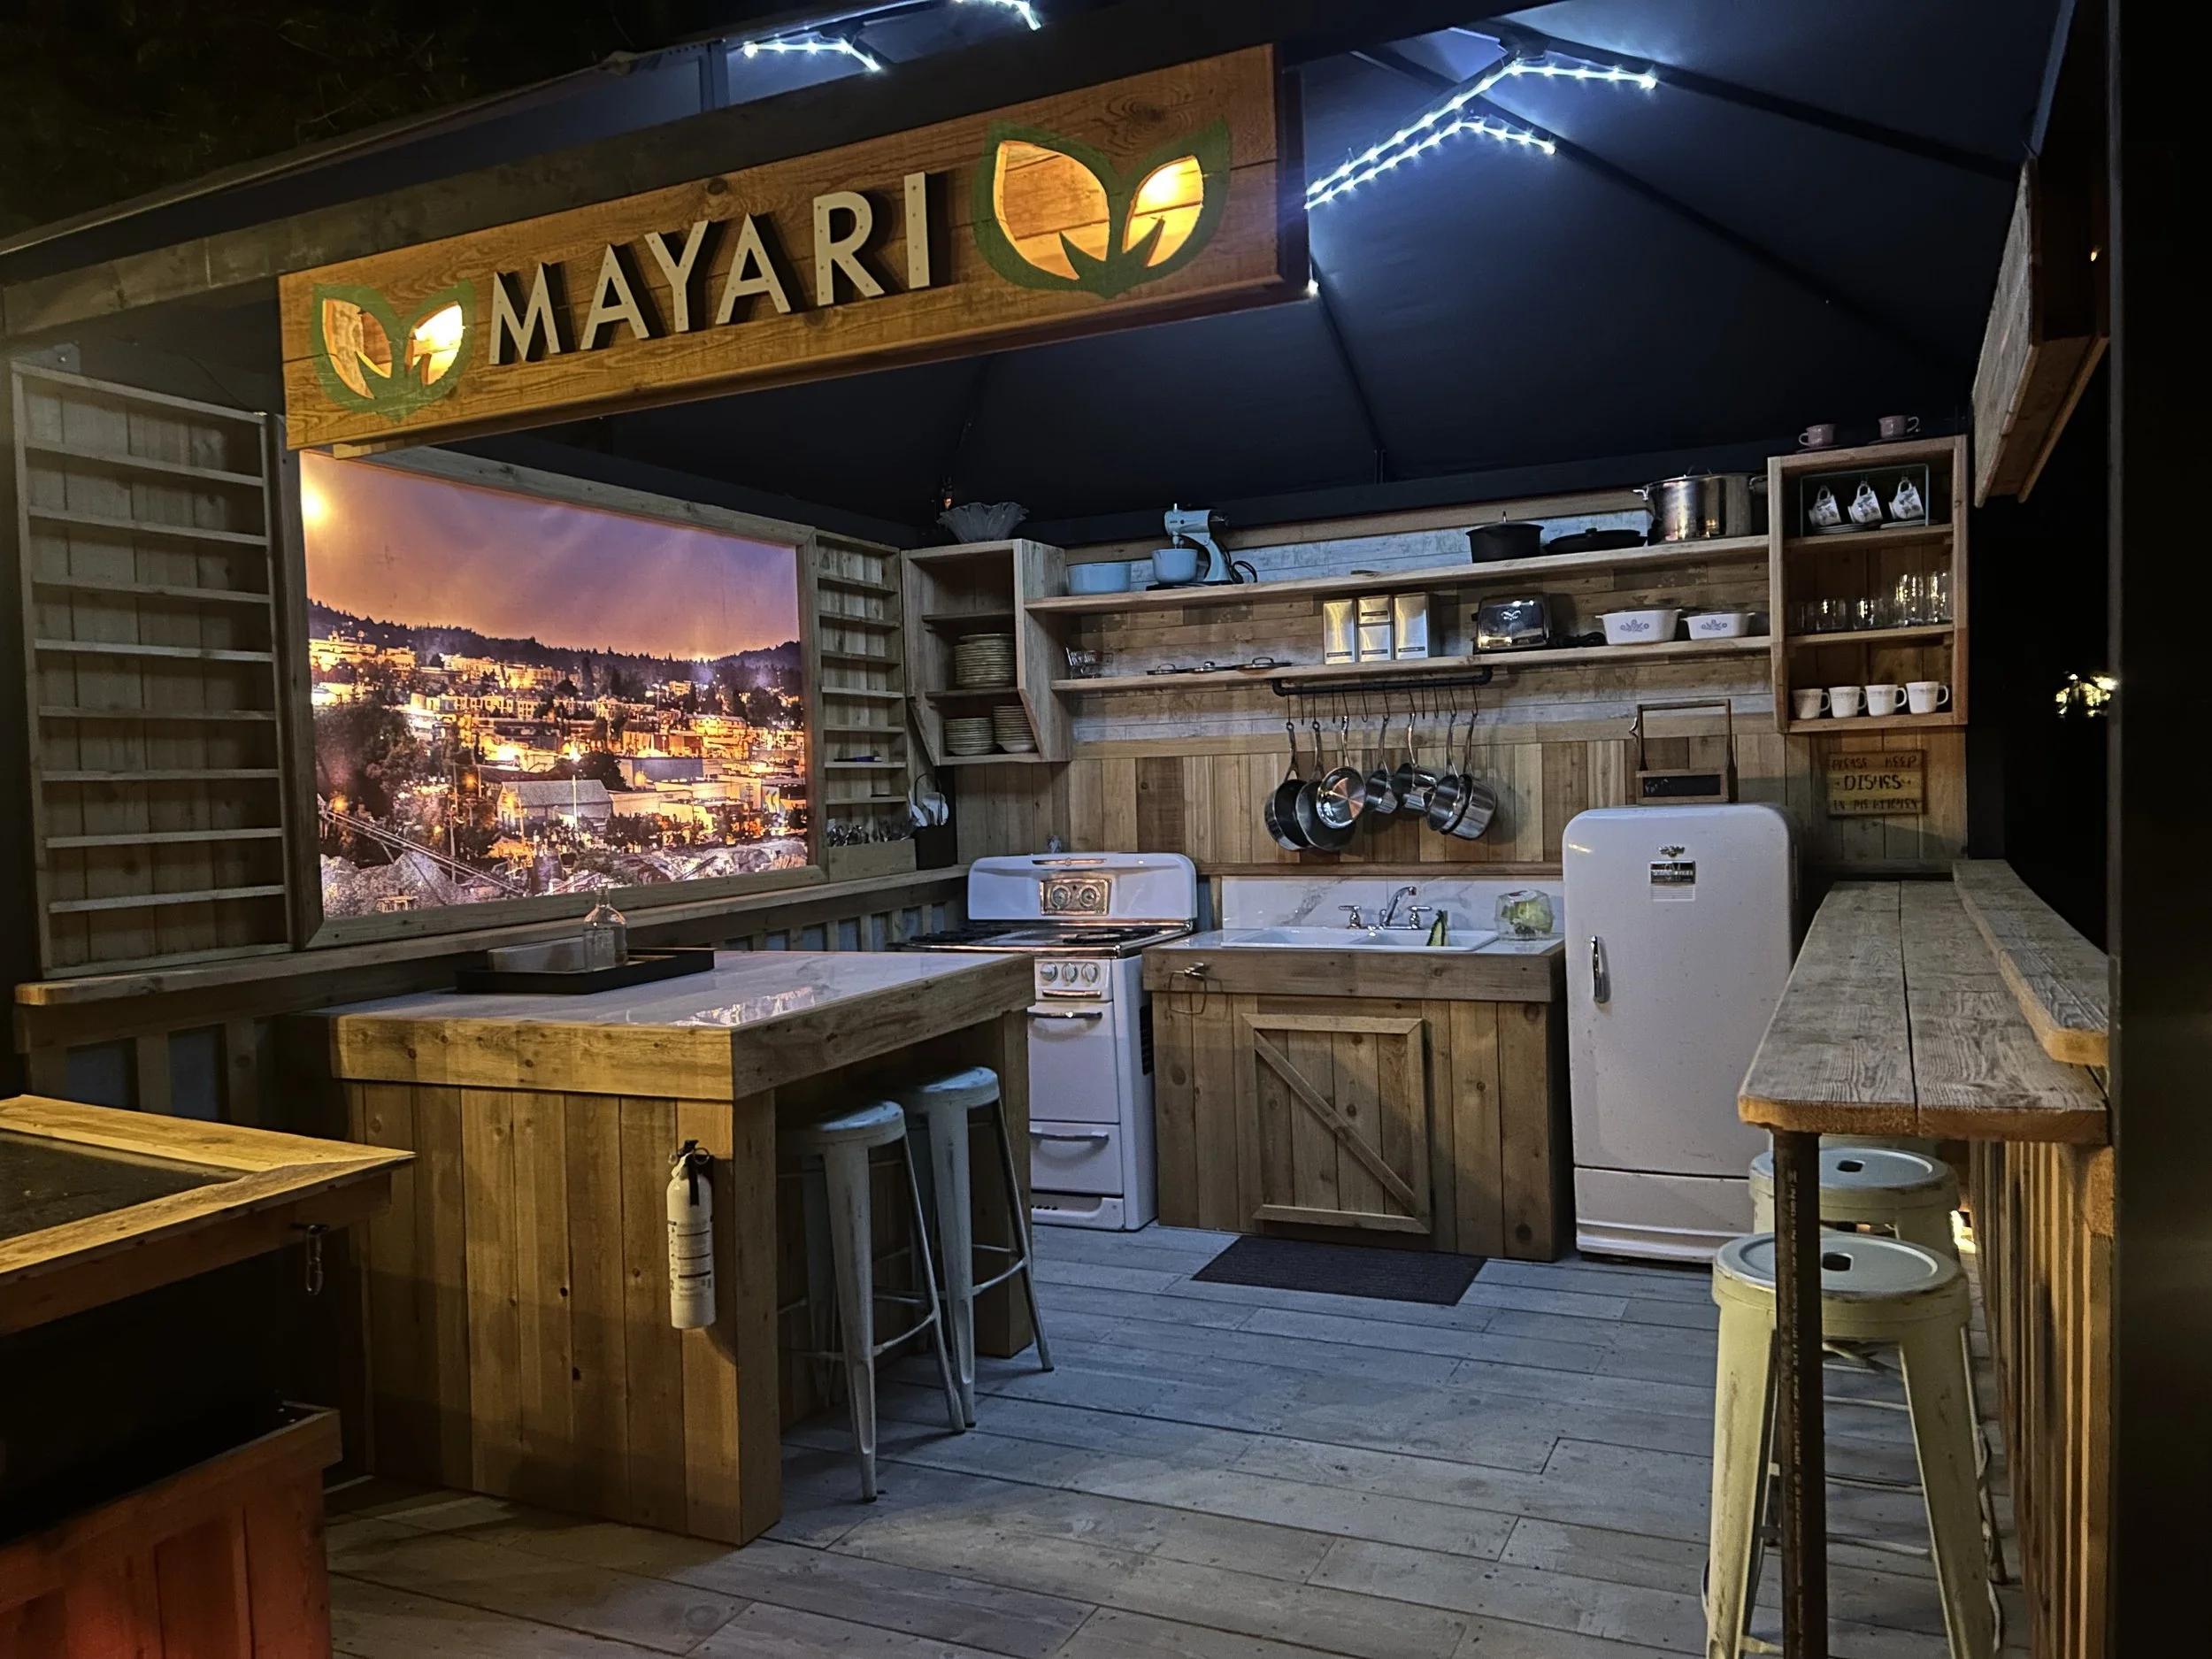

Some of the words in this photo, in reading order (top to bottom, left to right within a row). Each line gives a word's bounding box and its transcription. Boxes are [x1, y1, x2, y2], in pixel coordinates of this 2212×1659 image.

[488, 172, 931, 365] MAYARI
[1885, 756, 1916, 768] KEEP
[1843, 774, 1903, 790] DISHES
